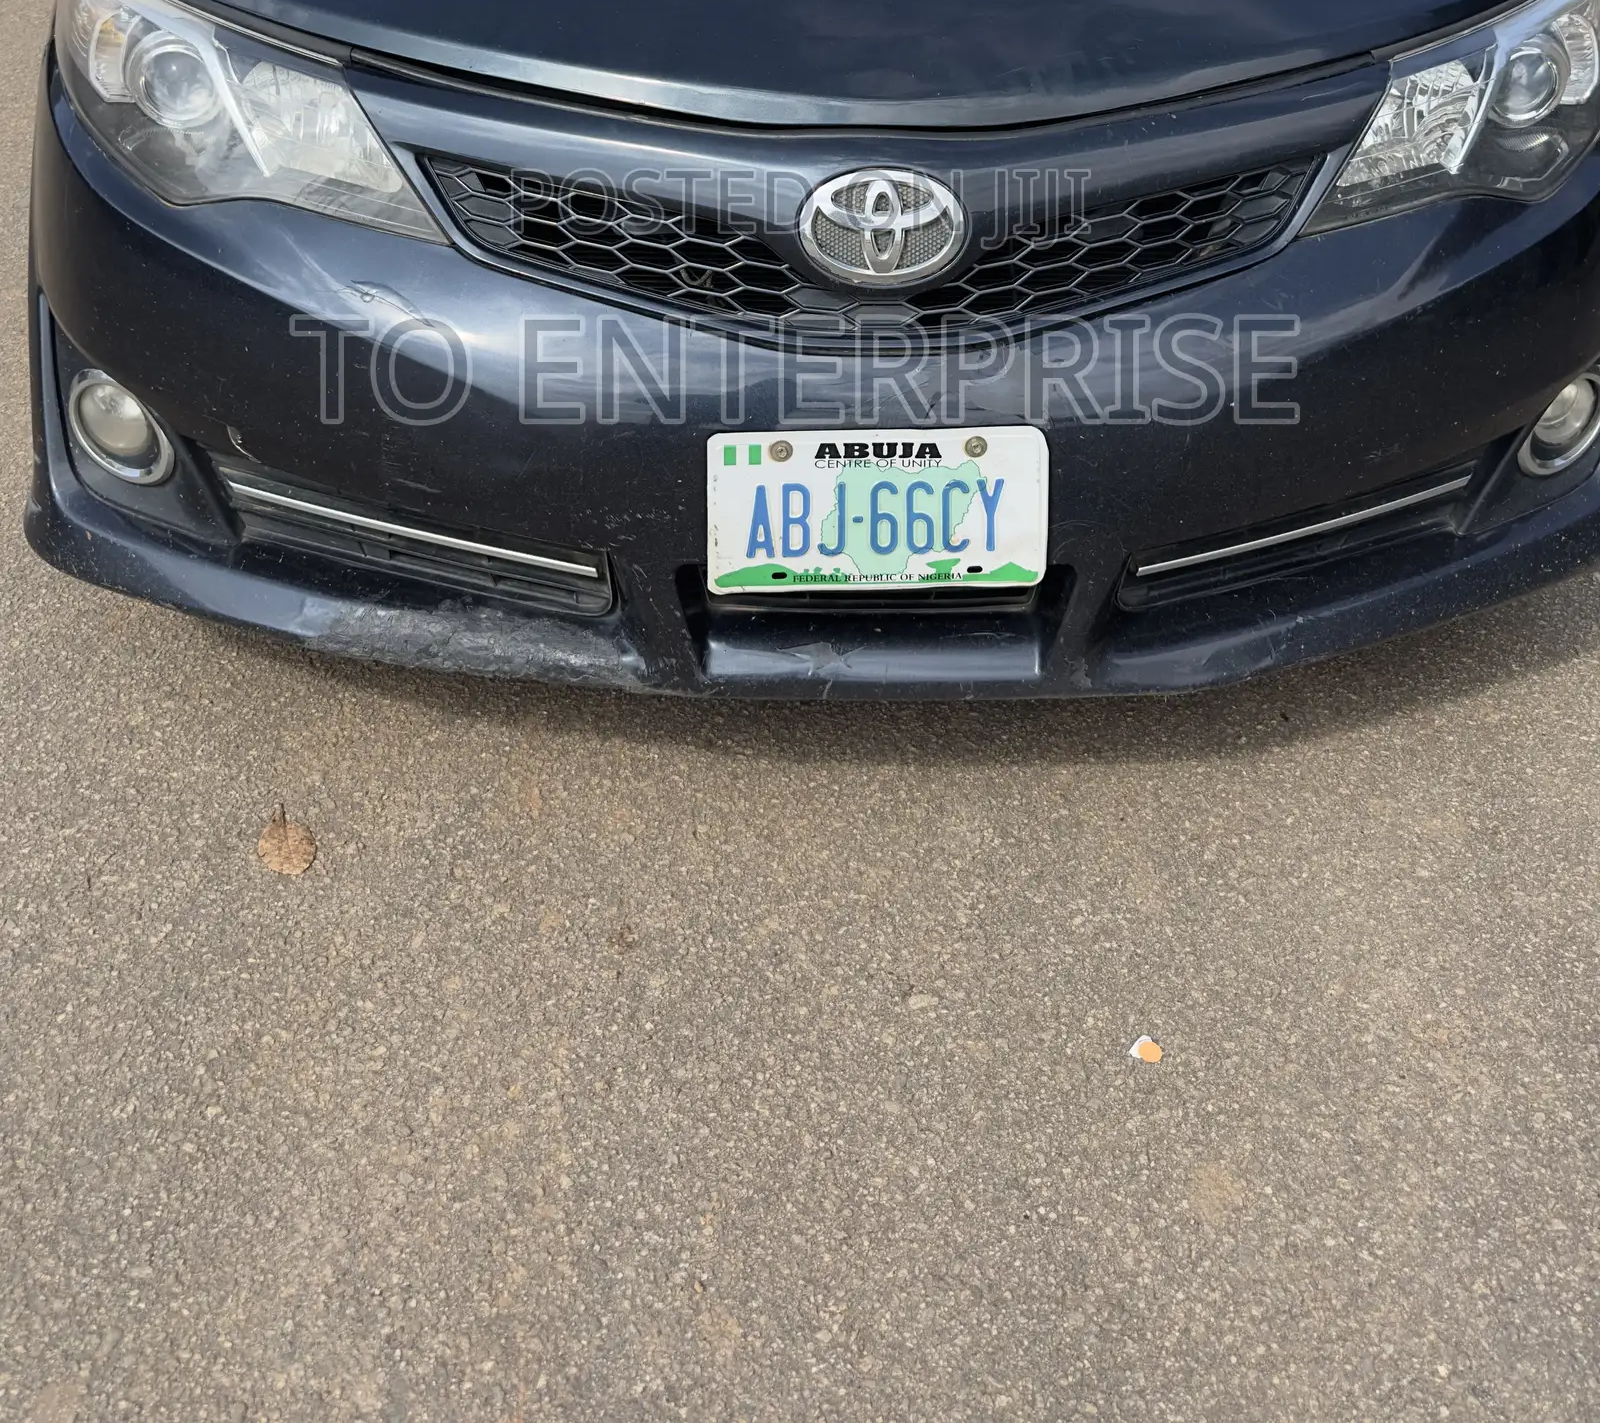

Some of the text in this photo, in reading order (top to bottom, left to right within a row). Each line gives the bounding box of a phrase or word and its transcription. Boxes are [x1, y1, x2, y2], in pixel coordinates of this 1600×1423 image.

[814, 442, 943, 459] ABUJA
[814, 458, 942, 469] CENTRE OF UNITY
[746, 478, 1005, 559] ABJ-66CY
[793, 572, 963, 583] FEDERAL REPUBLIC OF NIGERIA
